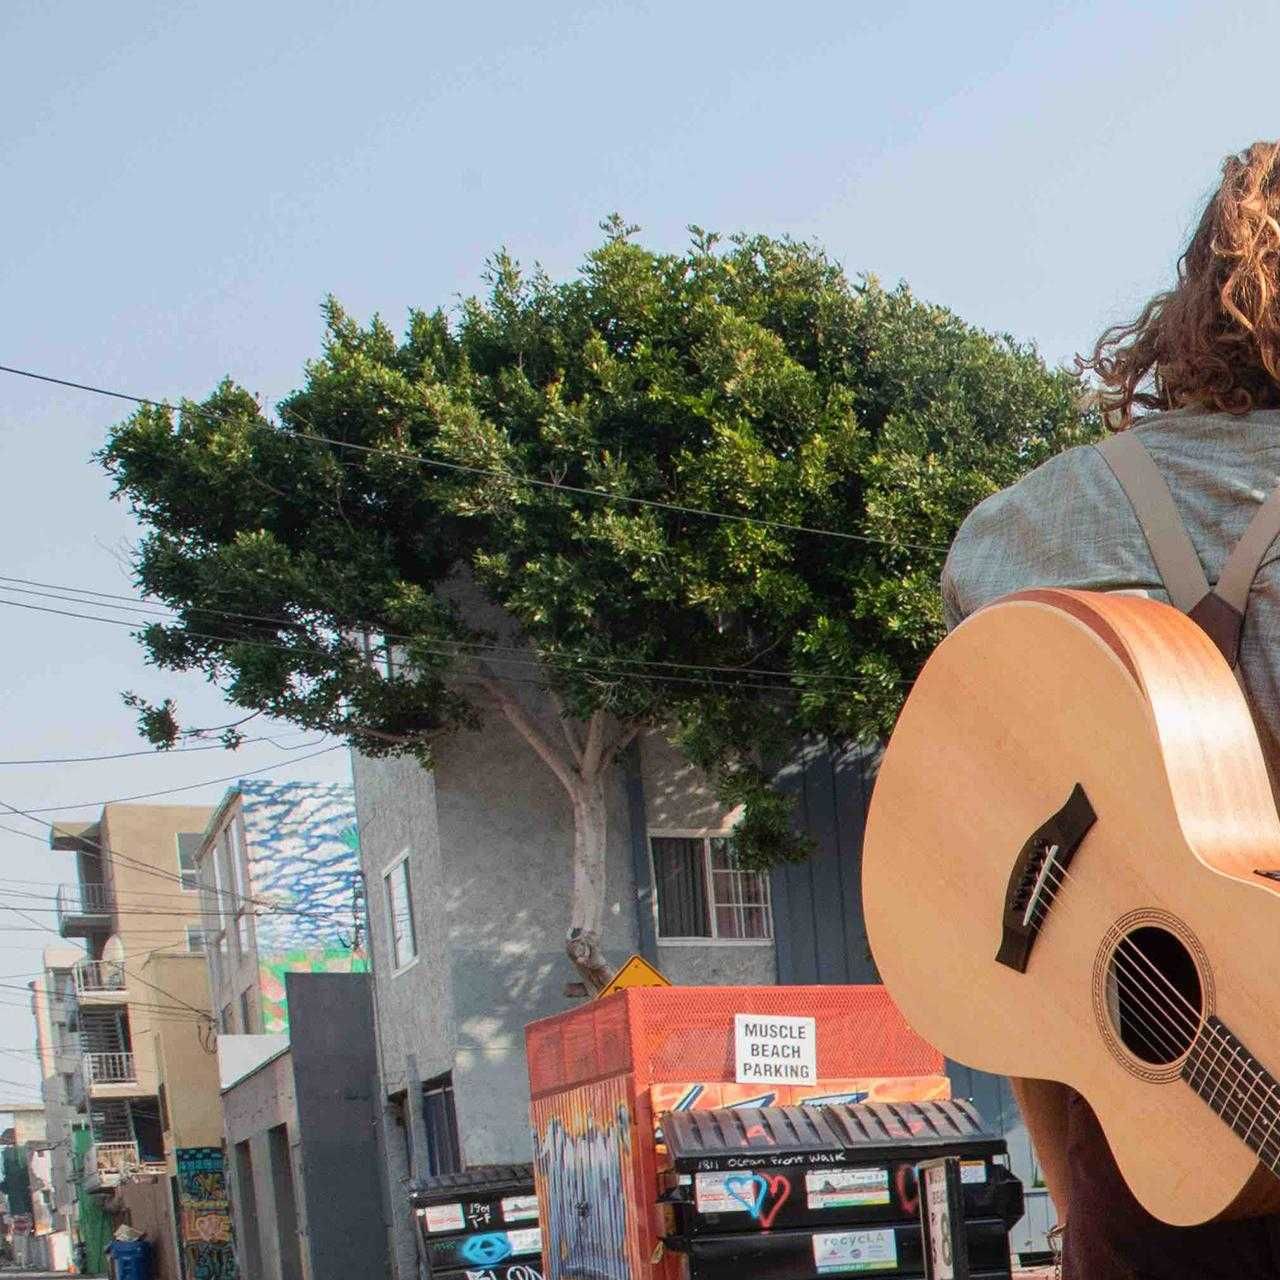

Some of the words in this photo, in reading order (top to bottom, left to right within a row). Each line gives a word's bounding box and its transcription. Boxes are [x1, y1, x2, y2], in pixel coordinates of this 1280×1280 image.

[744, 1022, 807, 1040] MUSCLE
[750, 1043, 801, 1059] BEACH
[743, 1062, 810, 1079] PARKING
